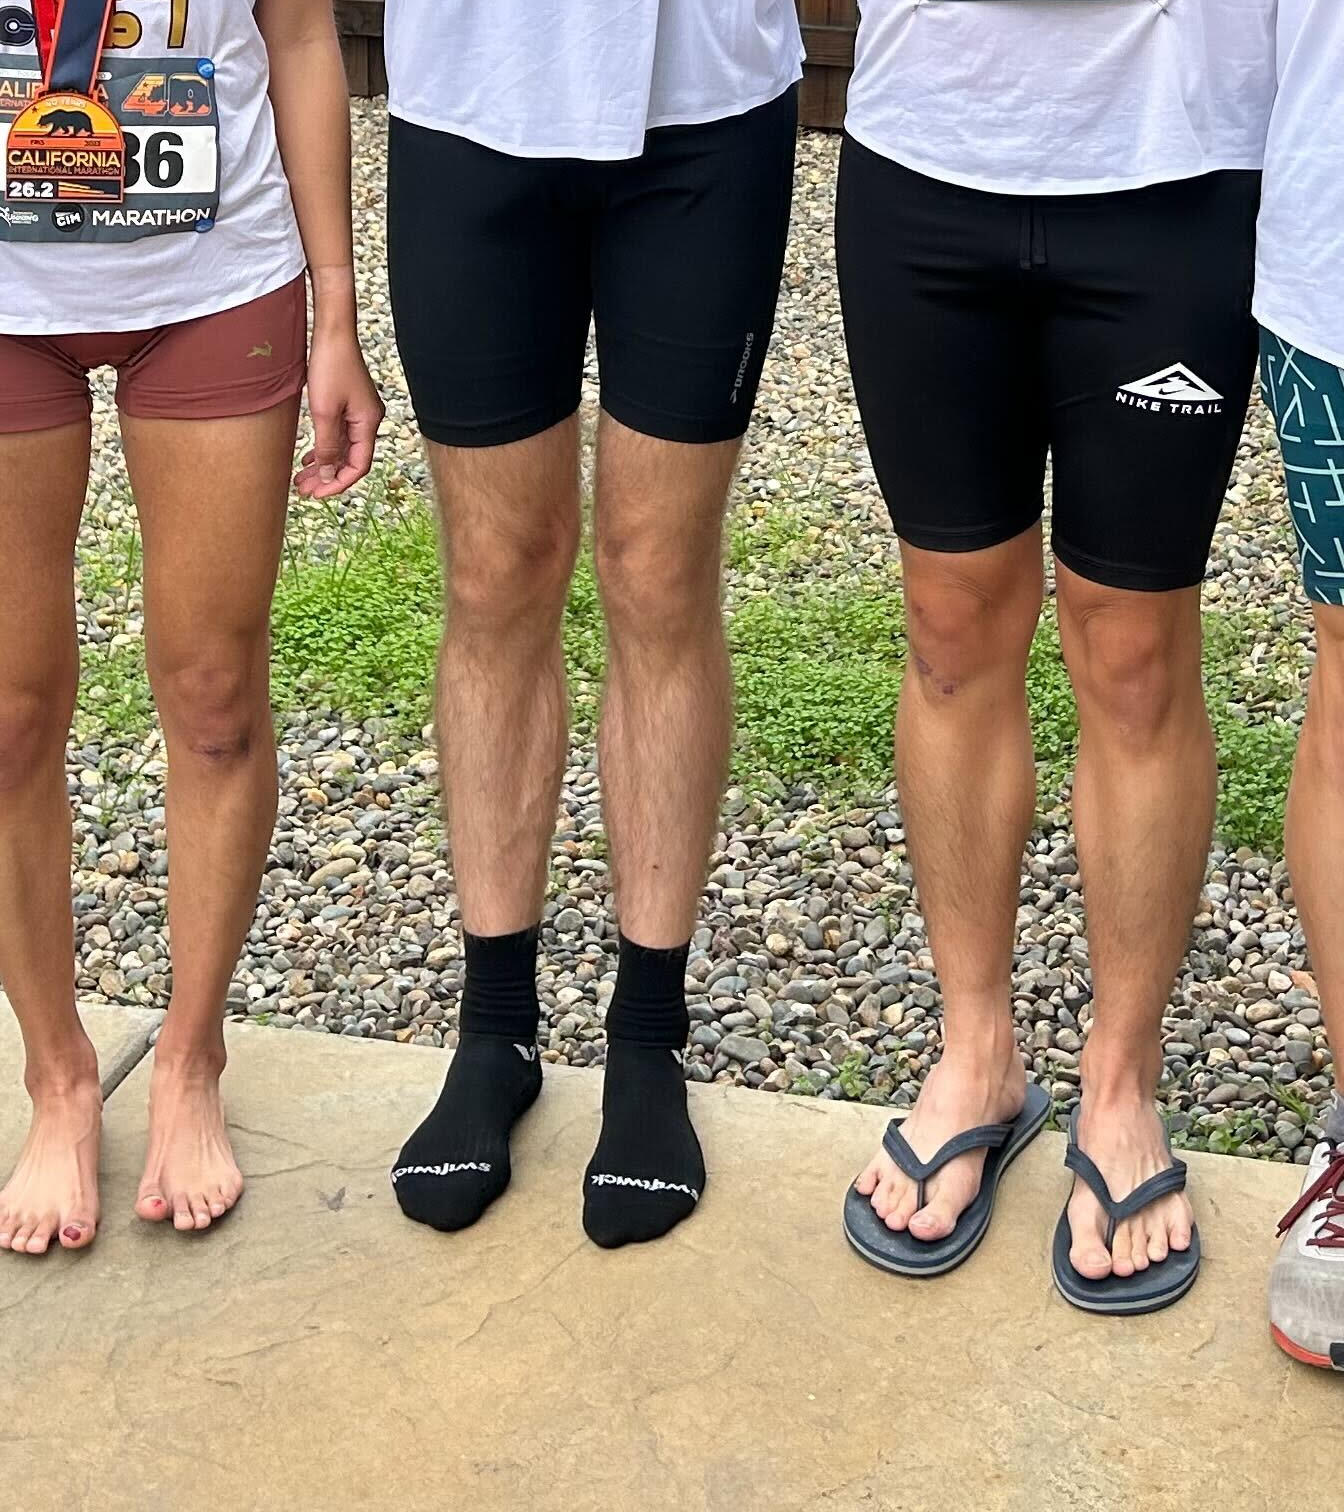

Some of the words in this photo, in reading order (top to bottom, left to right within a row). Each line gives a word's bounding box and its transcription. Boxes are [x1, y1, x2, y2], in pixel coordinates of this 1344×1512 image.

[8, 150, 121, 168] CALIFORNIA
[8, 181, 54, 198] 26.2
[92, 207, 211, 226] MARATHON
[1115, 391, 1161, 412] NIKE
[1170, 403, 1222, 415] TRAIL
